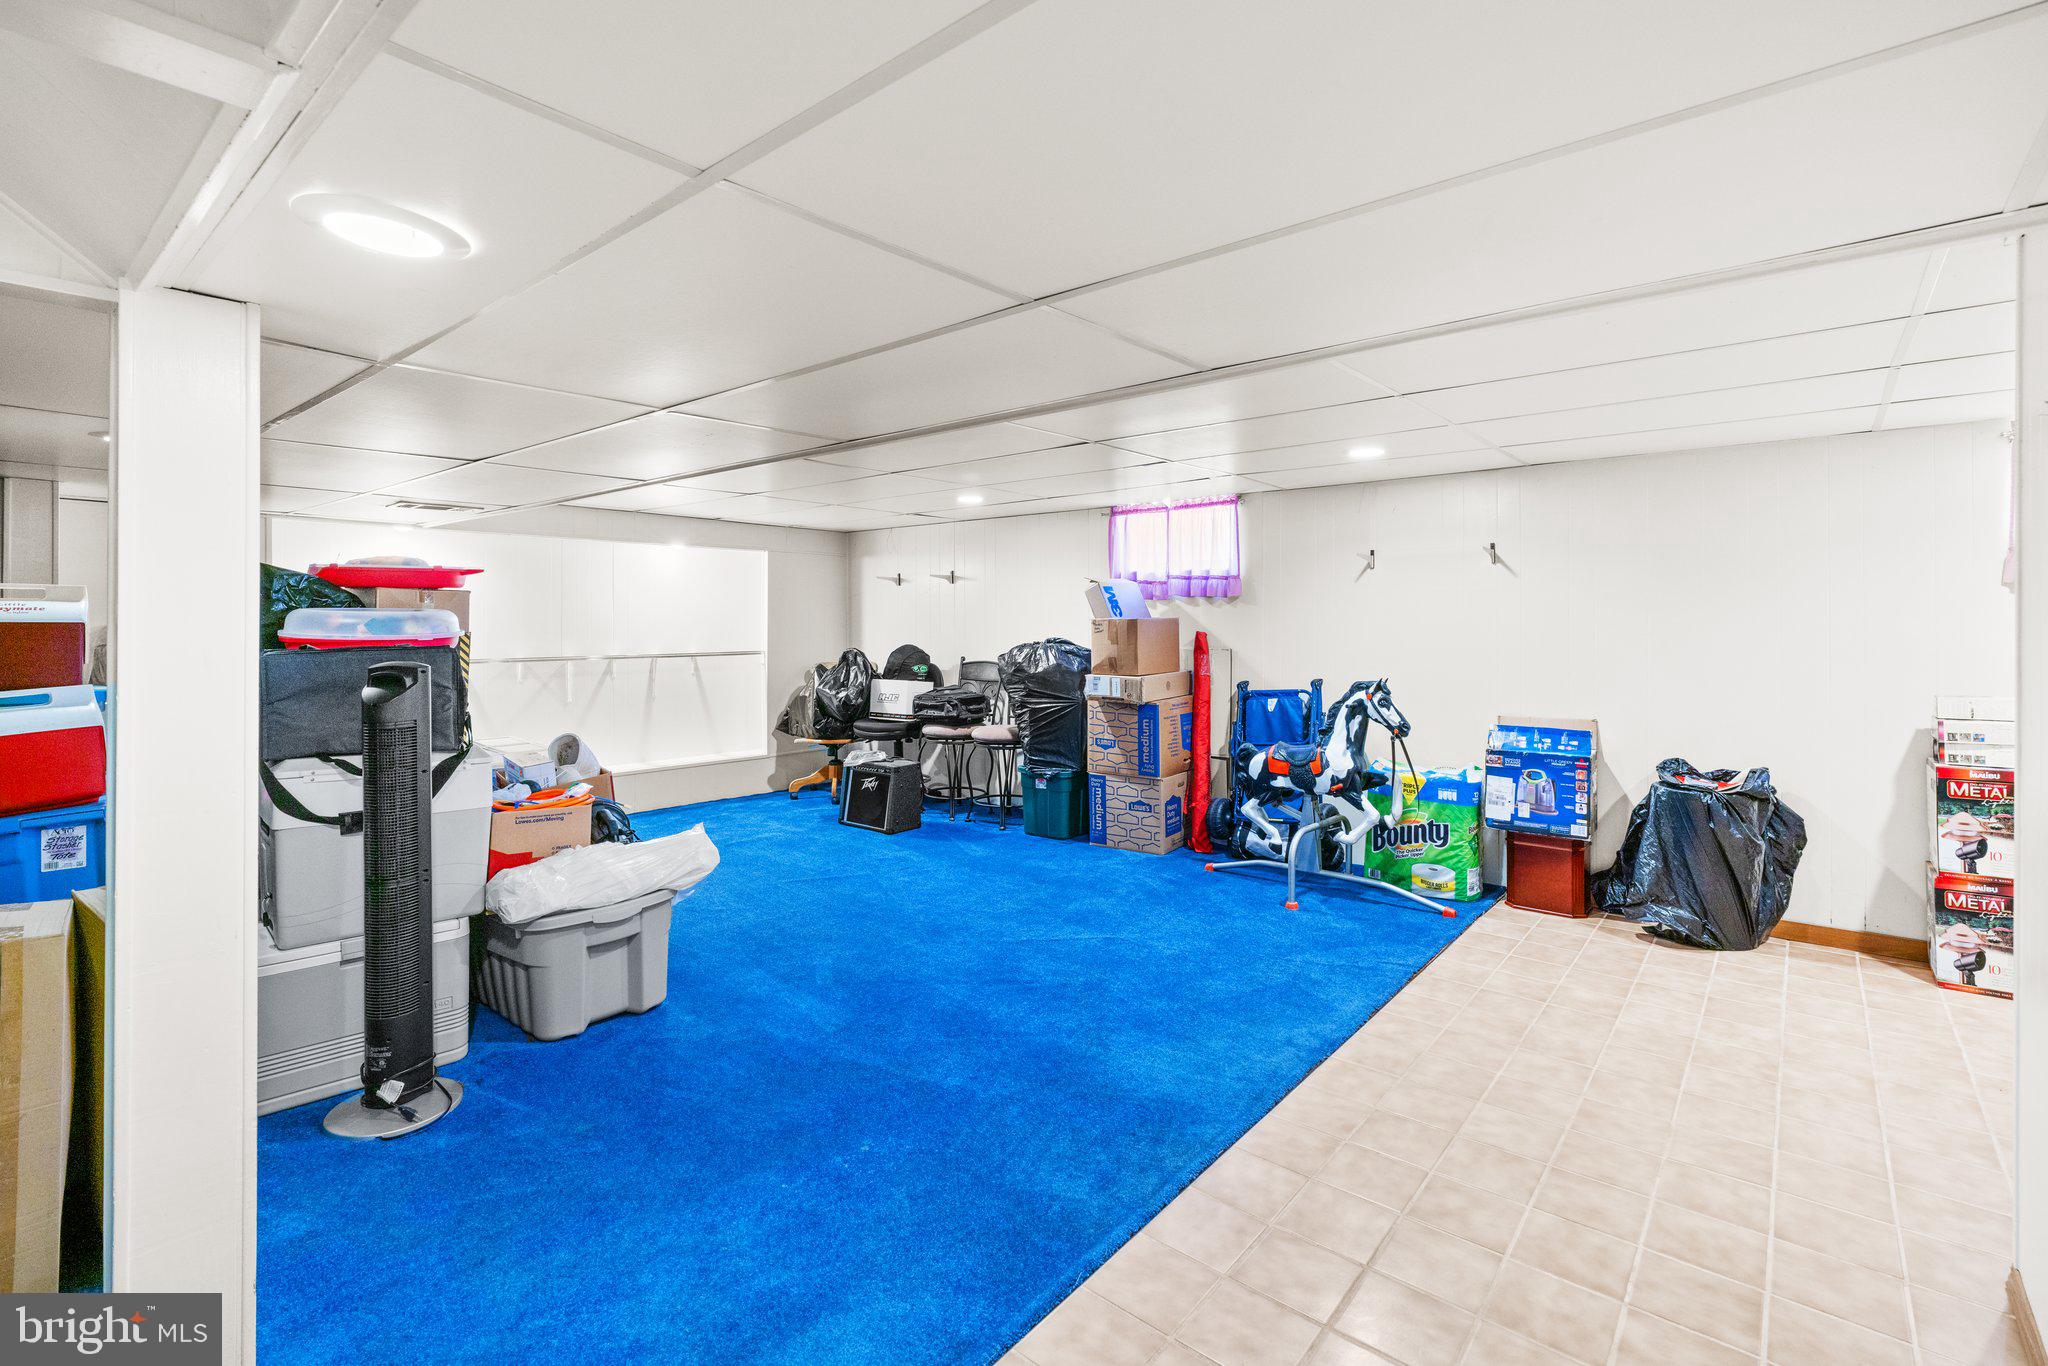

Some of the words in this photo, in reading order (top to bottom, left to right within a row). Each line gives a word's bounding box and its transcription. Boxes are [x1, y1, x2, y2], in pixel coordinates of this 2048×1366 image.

[1102, 586, 1122, 617] 3M
[1141, 719, 1150, 763] medium
[1949, 782, 2013, 799] METAL
[1096, 787, 1104, 830] medium
[1372, 819, 1449, 852] Bounty
[50, 852, 76, 860] Tote
[1947, 892, 2012, 913] METAL
